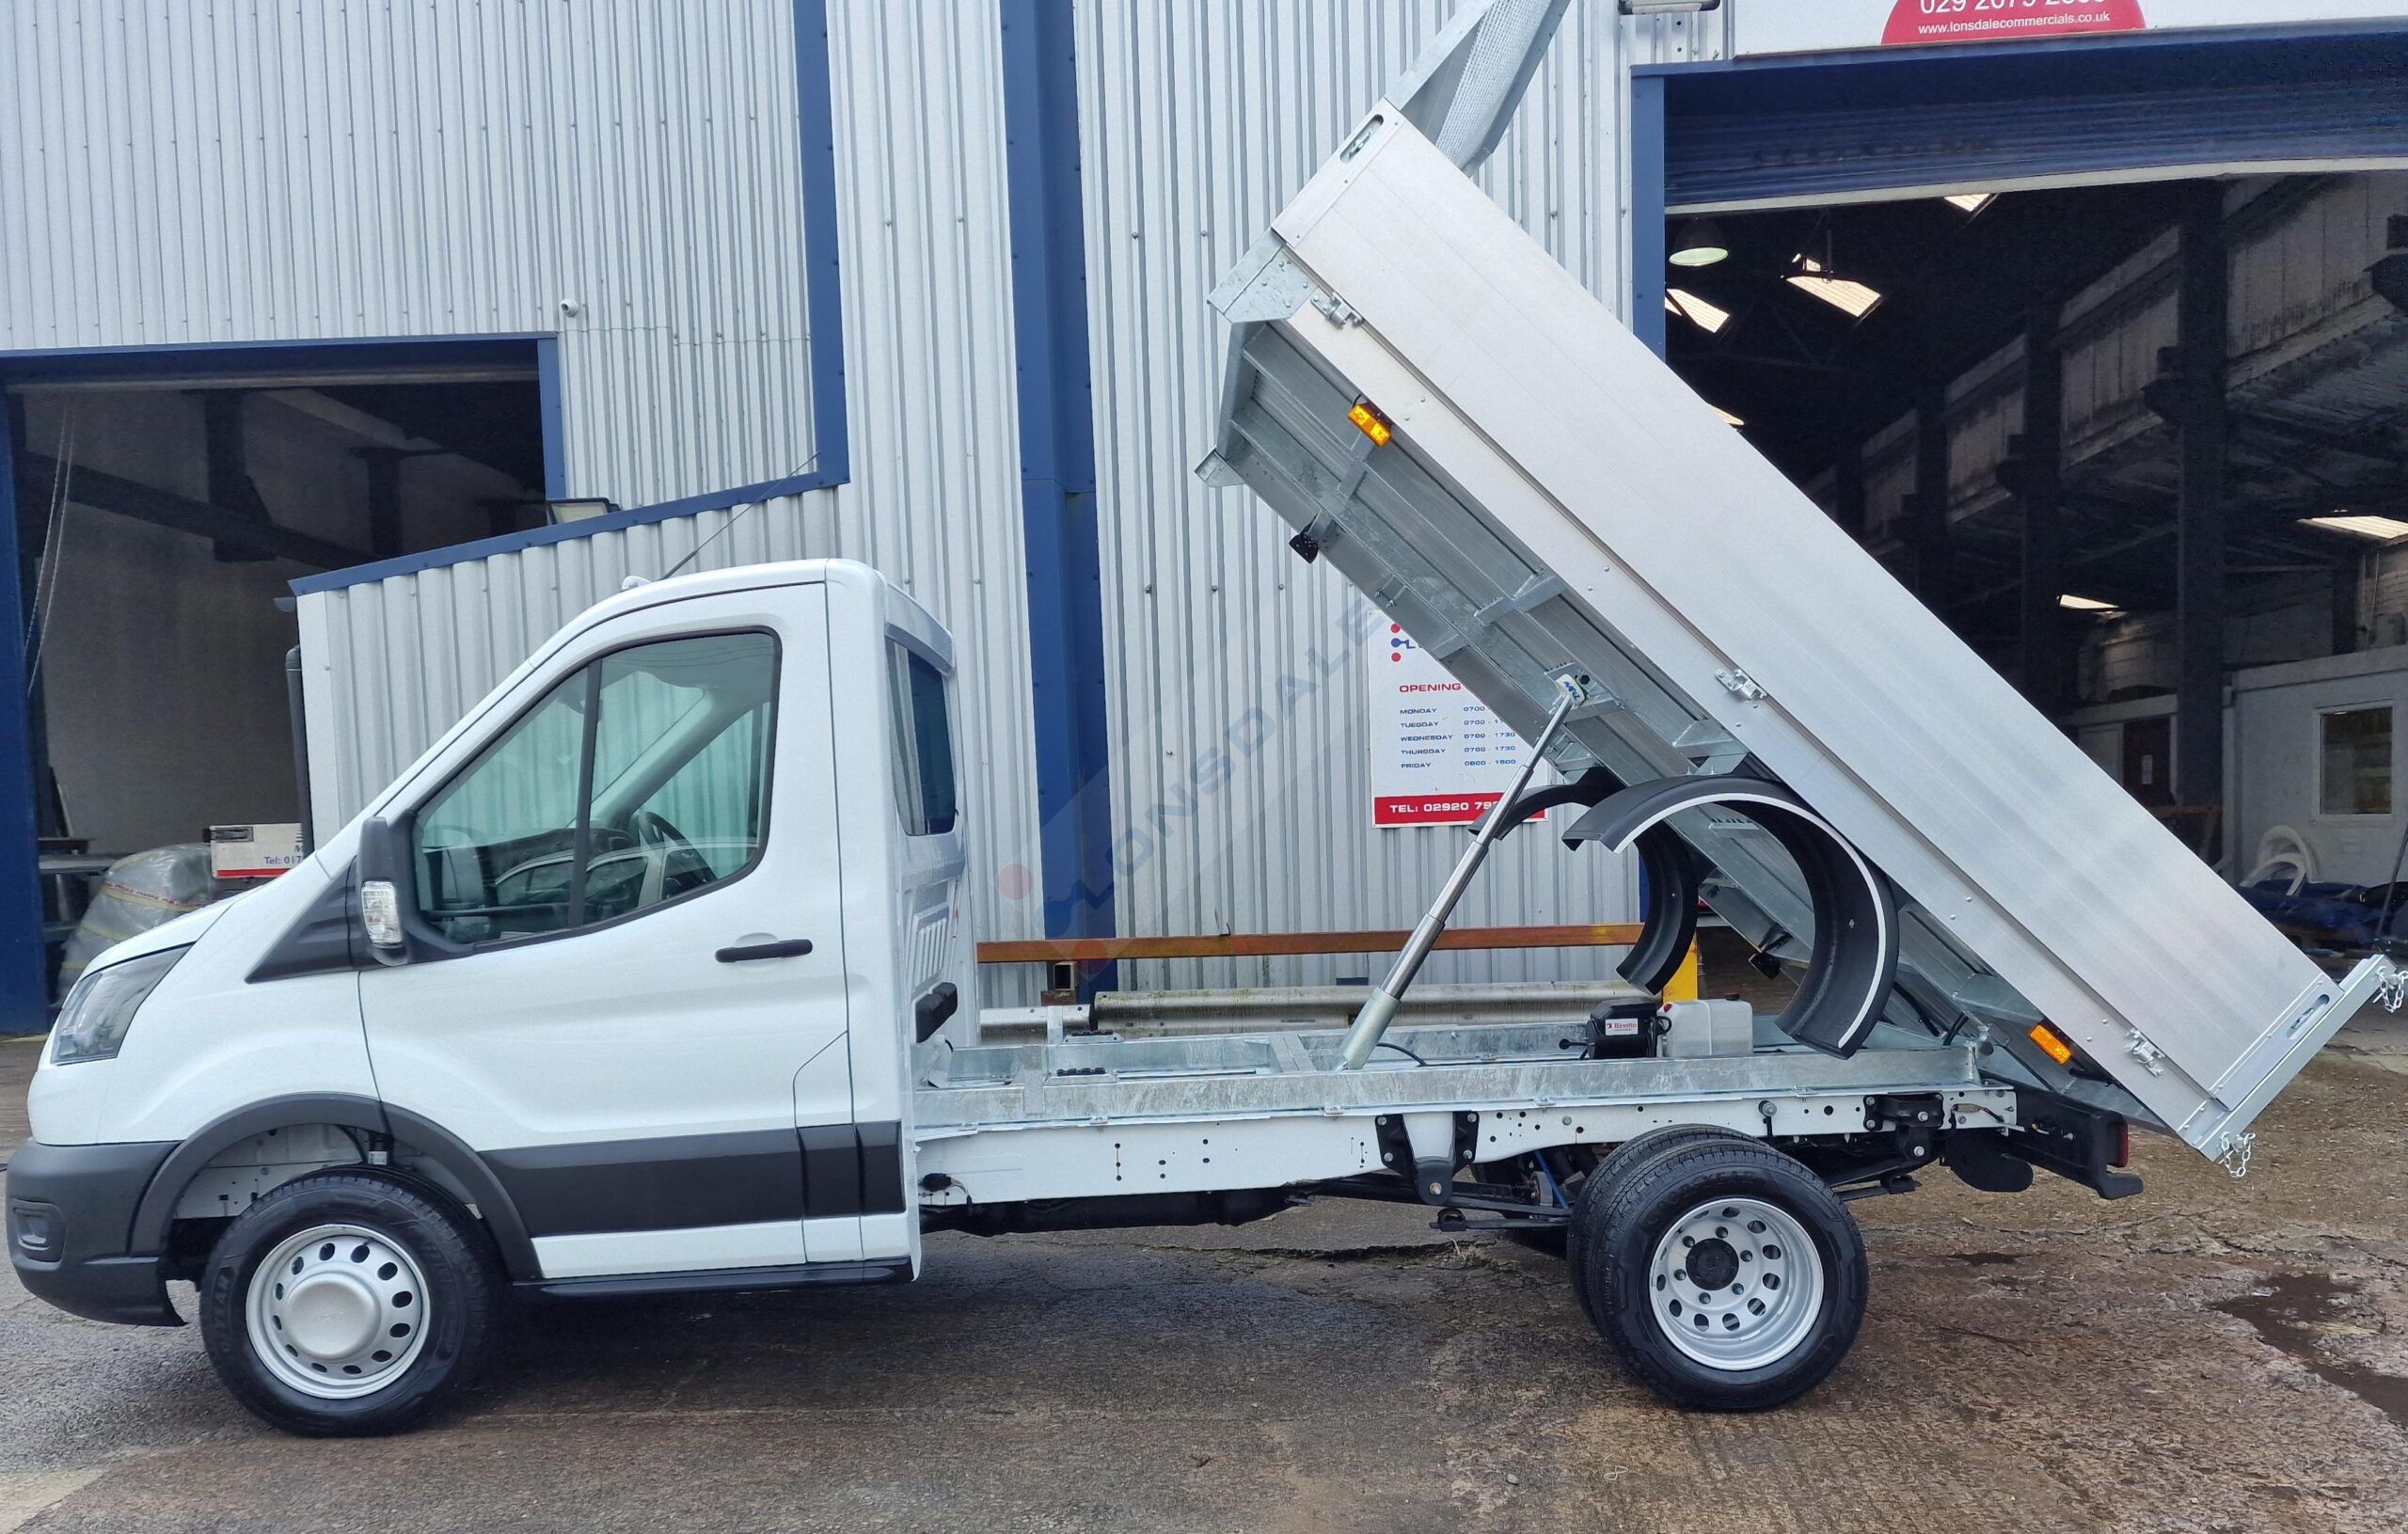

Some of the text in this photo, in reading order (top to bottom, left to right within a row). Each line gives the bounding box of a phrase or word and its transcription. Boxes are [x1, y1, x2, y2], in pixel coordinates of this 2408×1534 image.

[1918, 11, 2110, 34] www.lonsdalecommercials.co.uk
[1399, 683, 1461, 693] OPENING
[1389, 804, 1418, 814] TEL:
[1423, 802, 1469, 813] 02920
[263, 856, 282, 864] Tel:
